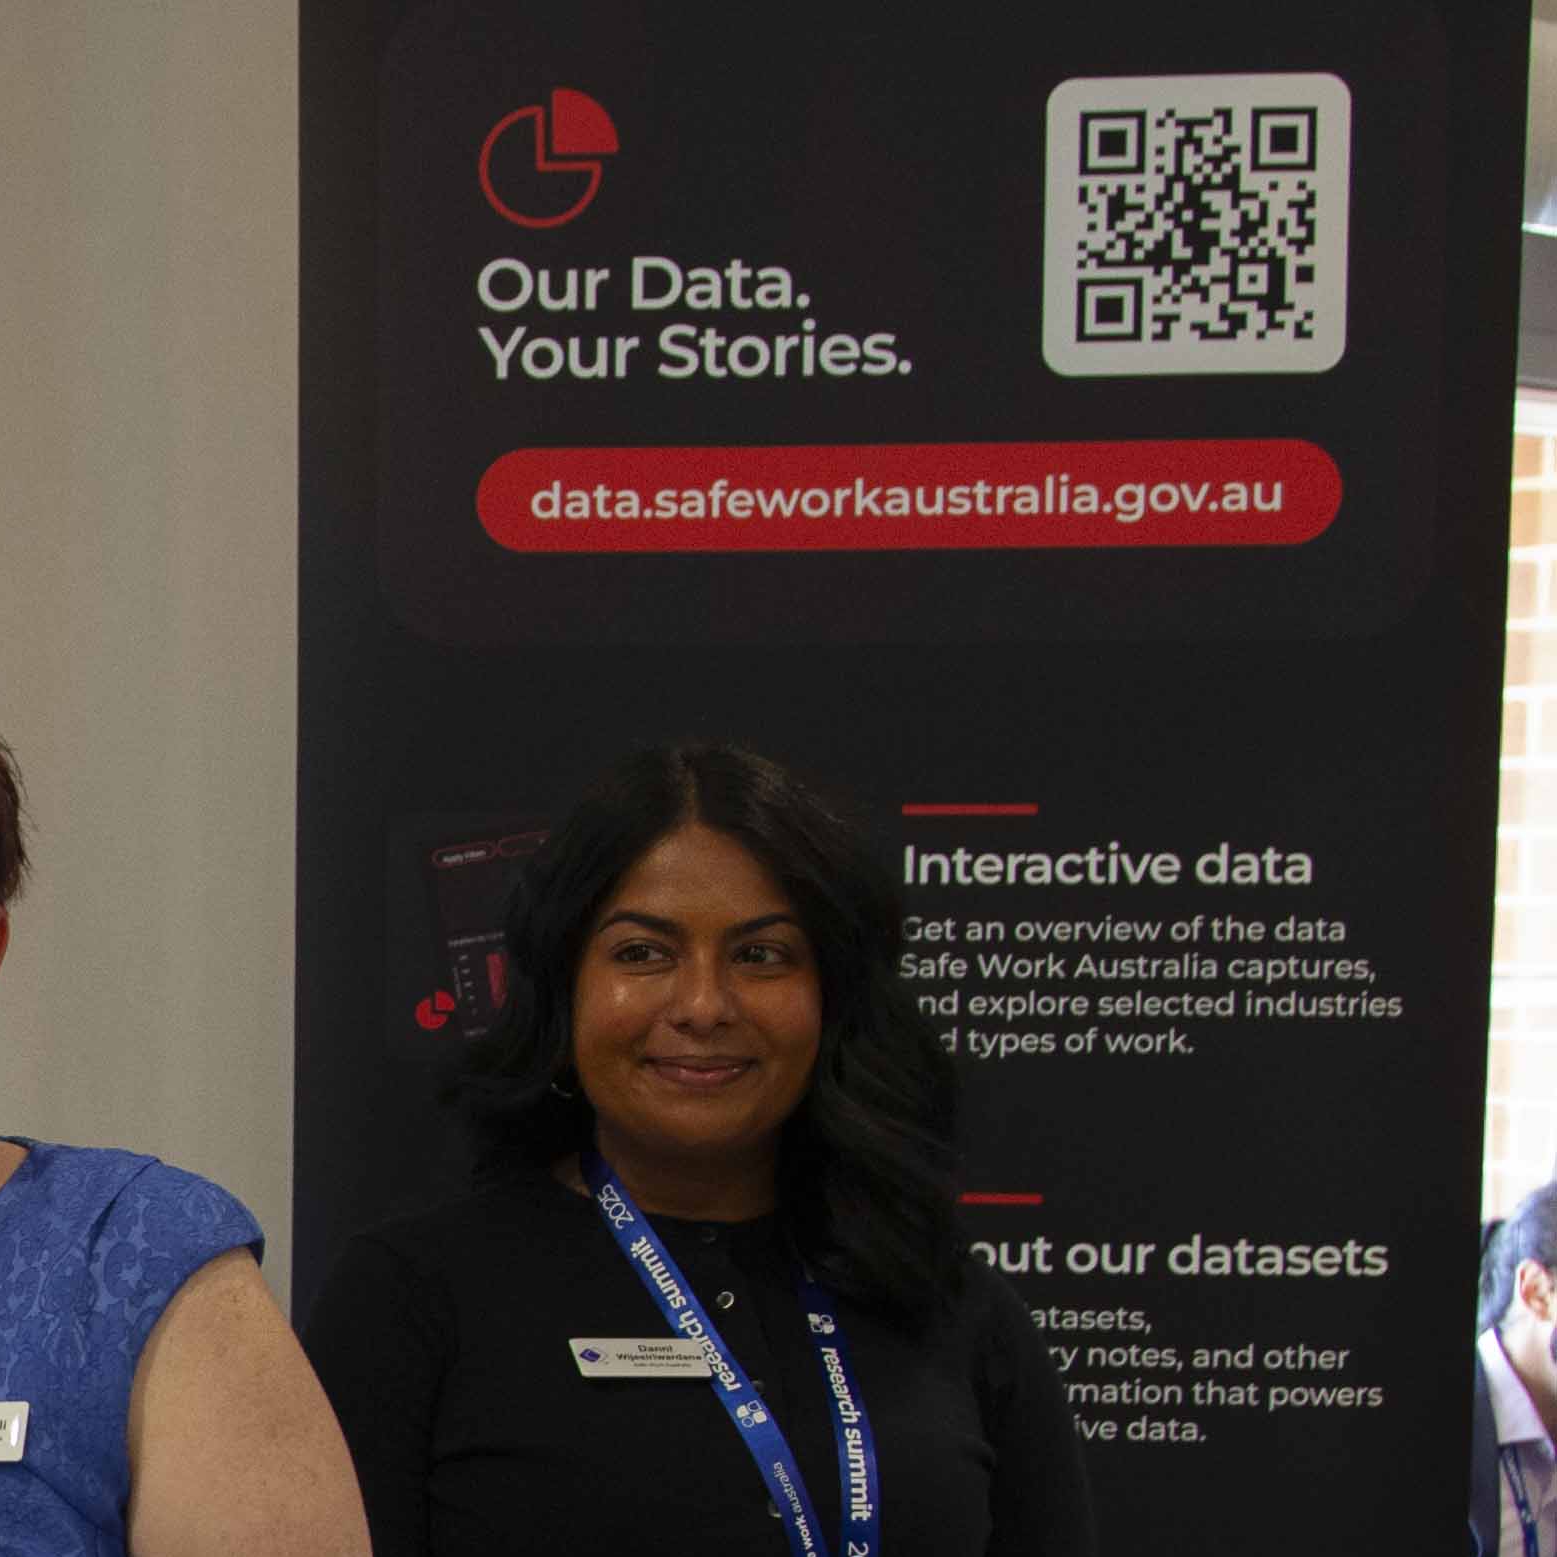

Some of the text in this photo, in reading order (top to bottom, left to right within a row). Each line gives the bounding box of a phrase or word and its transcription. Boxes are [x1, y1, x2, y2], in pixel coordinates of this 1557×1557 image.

[478, 257, 809, 311] Our Data.
[479, 319, 911, 378] Your Stories.
[531, 474, 1281, 522] data.safeworkaustralia.gov.au
[904, 841, 1312, 885] Interactive data
[903, 915, 1345, 942] Get an overview of the data
[900, 952, 1375, 984] Safe Work Australia captures,
[918, 990, 1402, 1021] nd explore selected industries
[967, 1029, 1056, 1058] types
[1065, 1027, 1098, 1053] of
[1105, 1027, 1194, 1053] work.
[630, 1236, 688, 1309] summit
[1066, 1243, 1155, 1274] our
[1168, 1234, 1388, 1276] datasets
[1031, 1306, 1151, 1334] atasets,
[678, 1303, 742, 1394] research
[1088, 1345, 1183, 1371] notes,
[1193, 1344, 1254, 1368] and
[1264, 1344, 1350, 1370] other
[1192, 1380, 1259, 1406] that
[1269, 1387, 1382, 1411] powers
[821, 1346, 861, 1424] research
[844, 1427, 873, 1521] summit
[1126, 1416, 1206, 1441] data.
[795, 1514, 814, 1551] work
